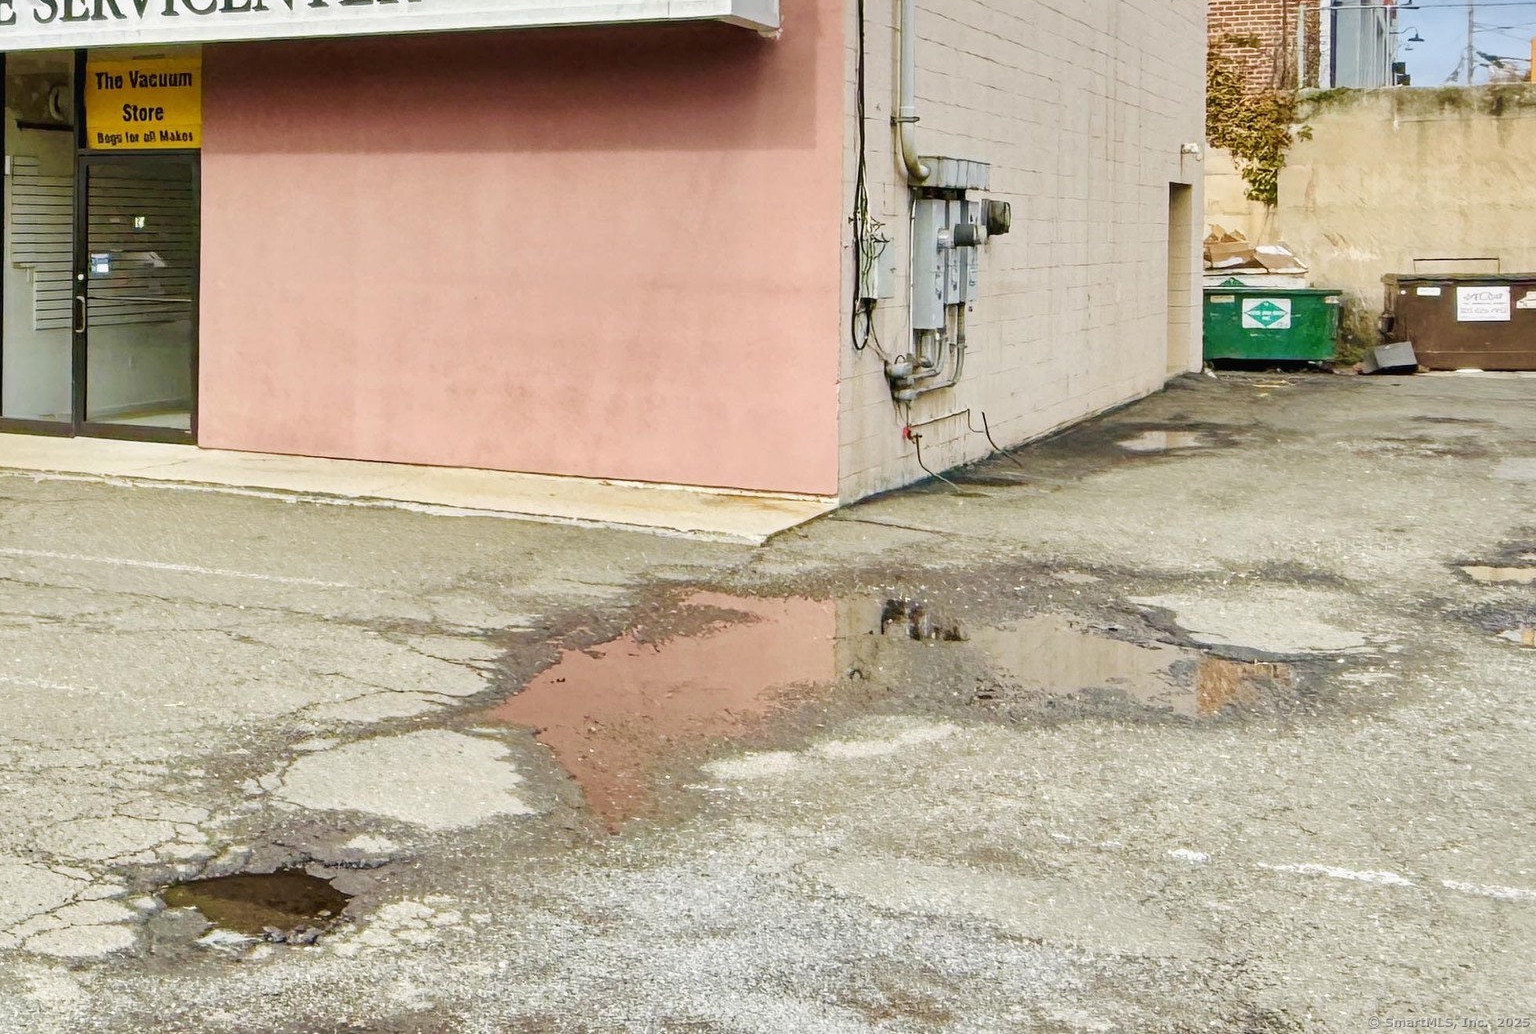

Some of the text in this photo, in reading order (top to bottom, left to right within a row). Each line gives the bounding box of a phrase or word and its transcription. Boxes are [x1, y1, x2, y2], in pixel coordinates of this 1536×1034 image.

[95, 70, 192, 90] The Vacuum
[122, 103, 164, 122] Store
[97, 130, 193, 145] Bags for all Makes
